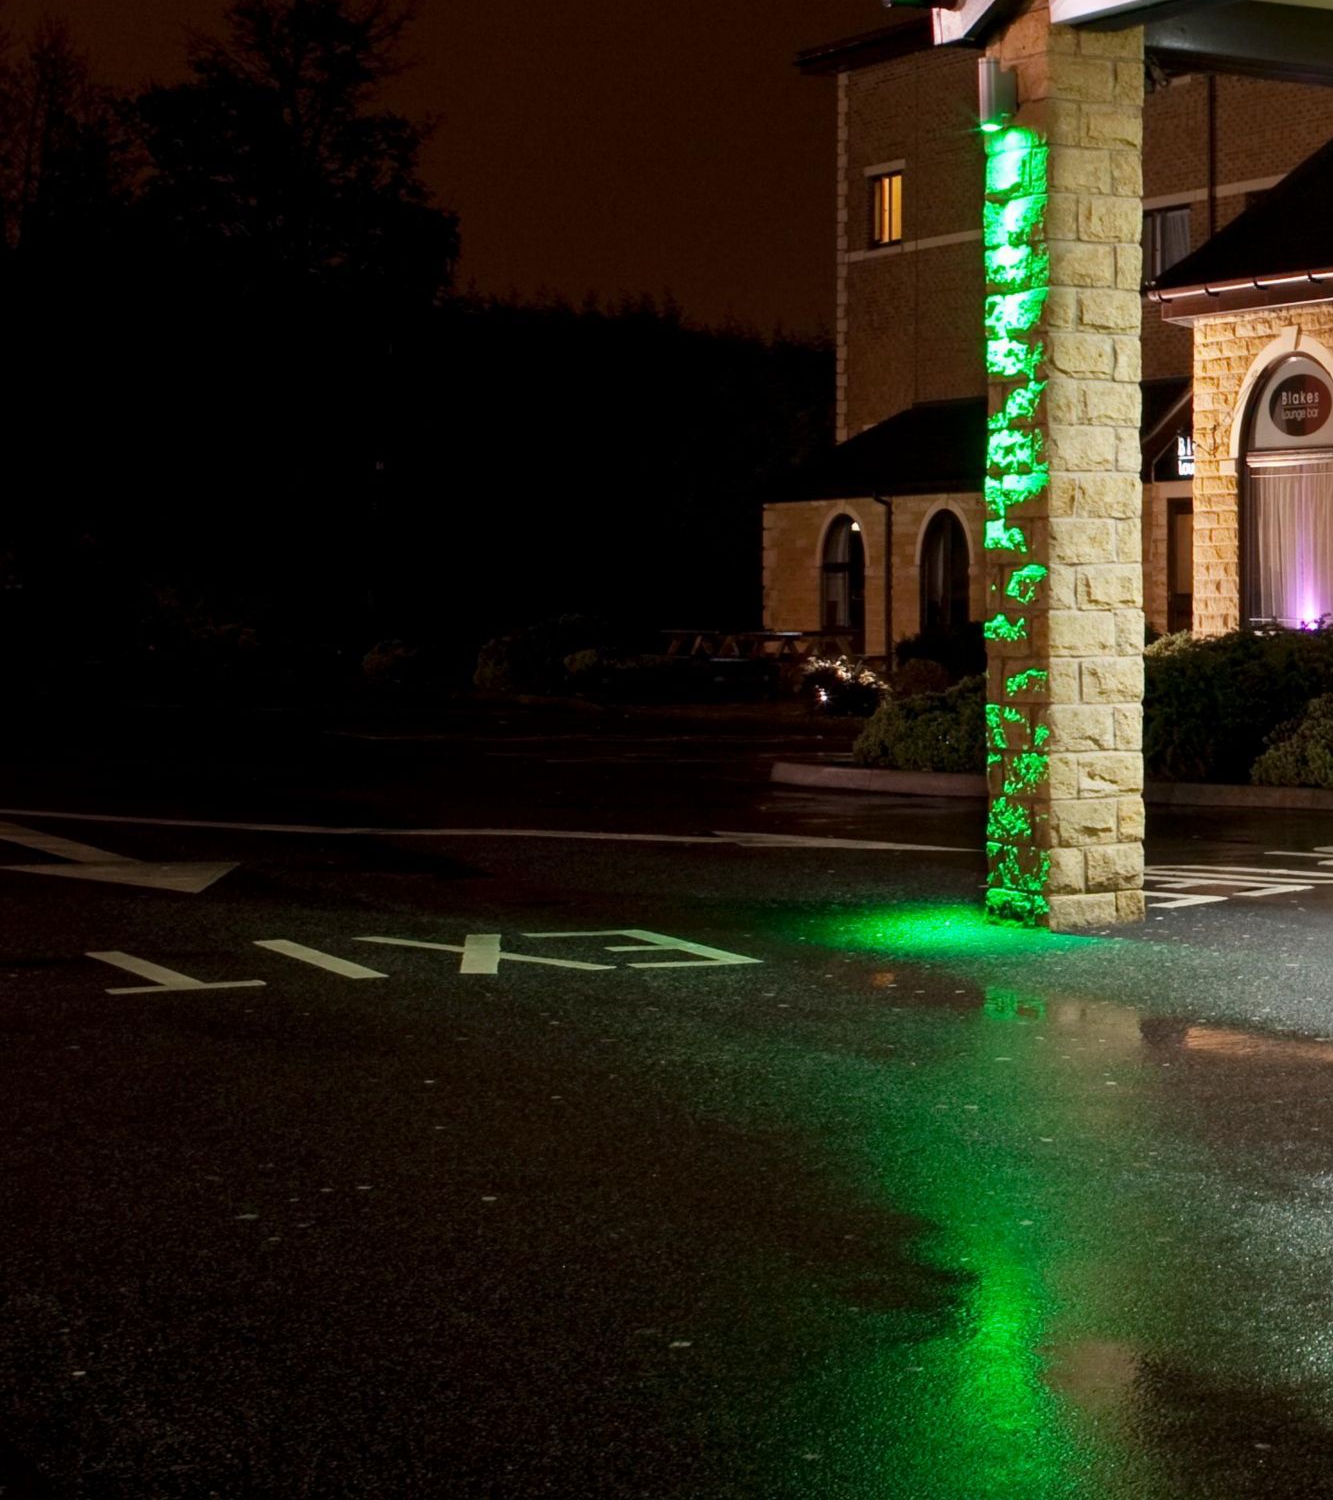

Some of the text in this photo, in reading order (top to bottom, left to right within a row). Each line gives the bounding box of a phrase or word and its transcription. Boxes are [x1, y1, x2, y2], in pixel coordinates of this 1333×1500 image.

[1281, 392, 1319, 405] Blakes
[1281, 408, 1319, 421] Lounge bar
[84, 929, 764, 995] EXIT
